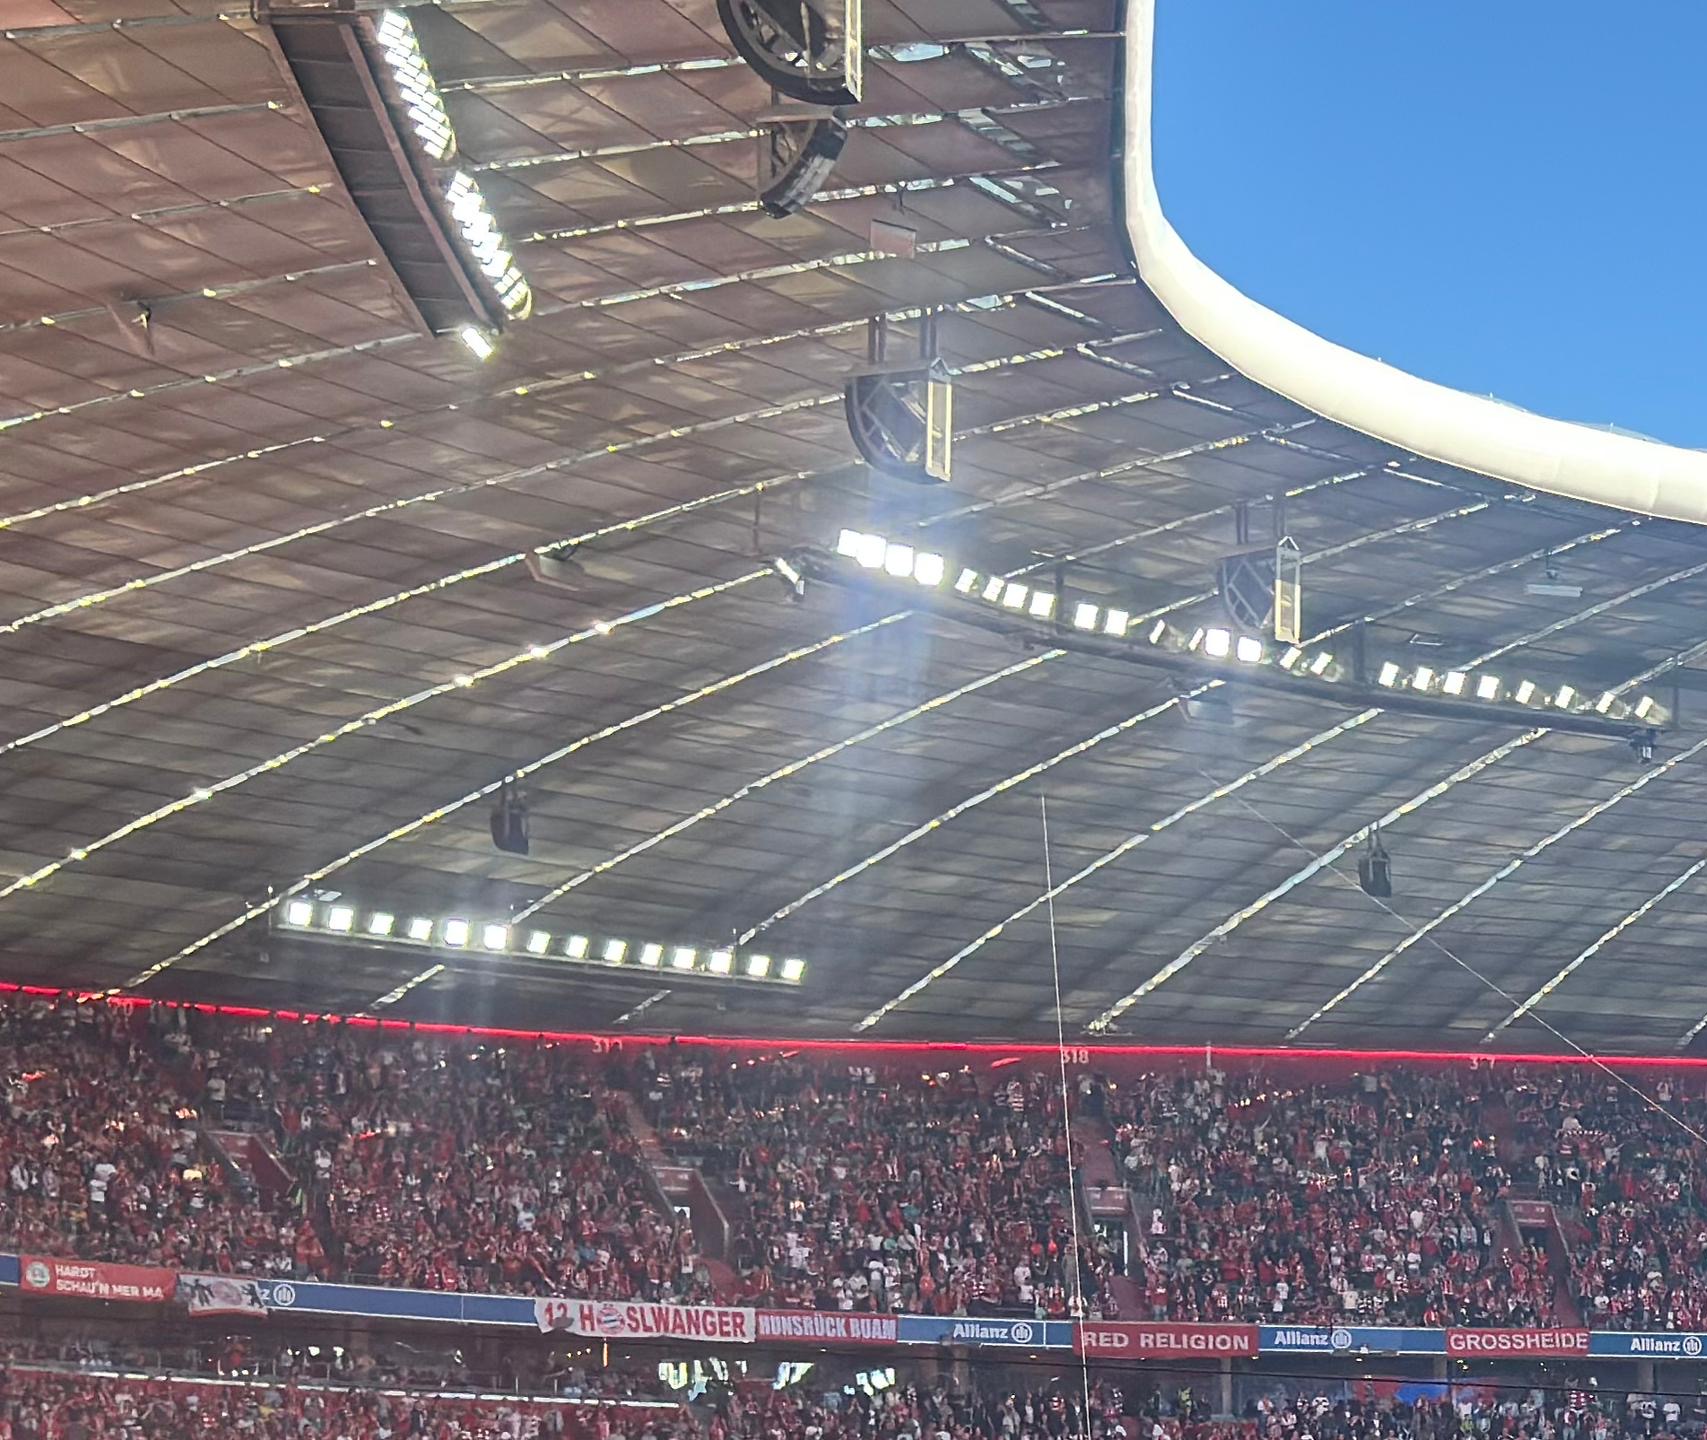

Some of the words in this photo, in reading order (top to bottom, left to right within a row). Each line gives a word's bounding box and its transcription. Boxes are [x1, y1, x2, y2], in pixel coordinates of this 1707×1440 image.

[953, 1323, 1008, 1341] Allianz
[1085, 1331, 1129, 1349] RED
[1140, 1333, 1249, 1351] RELIGION
[1274, 1330, 1328, 1346] Allianz
[1450, 1332, 1588, 1351] GROSSHEIDE
[1630, 1337, 1681, 1353] Allianz
